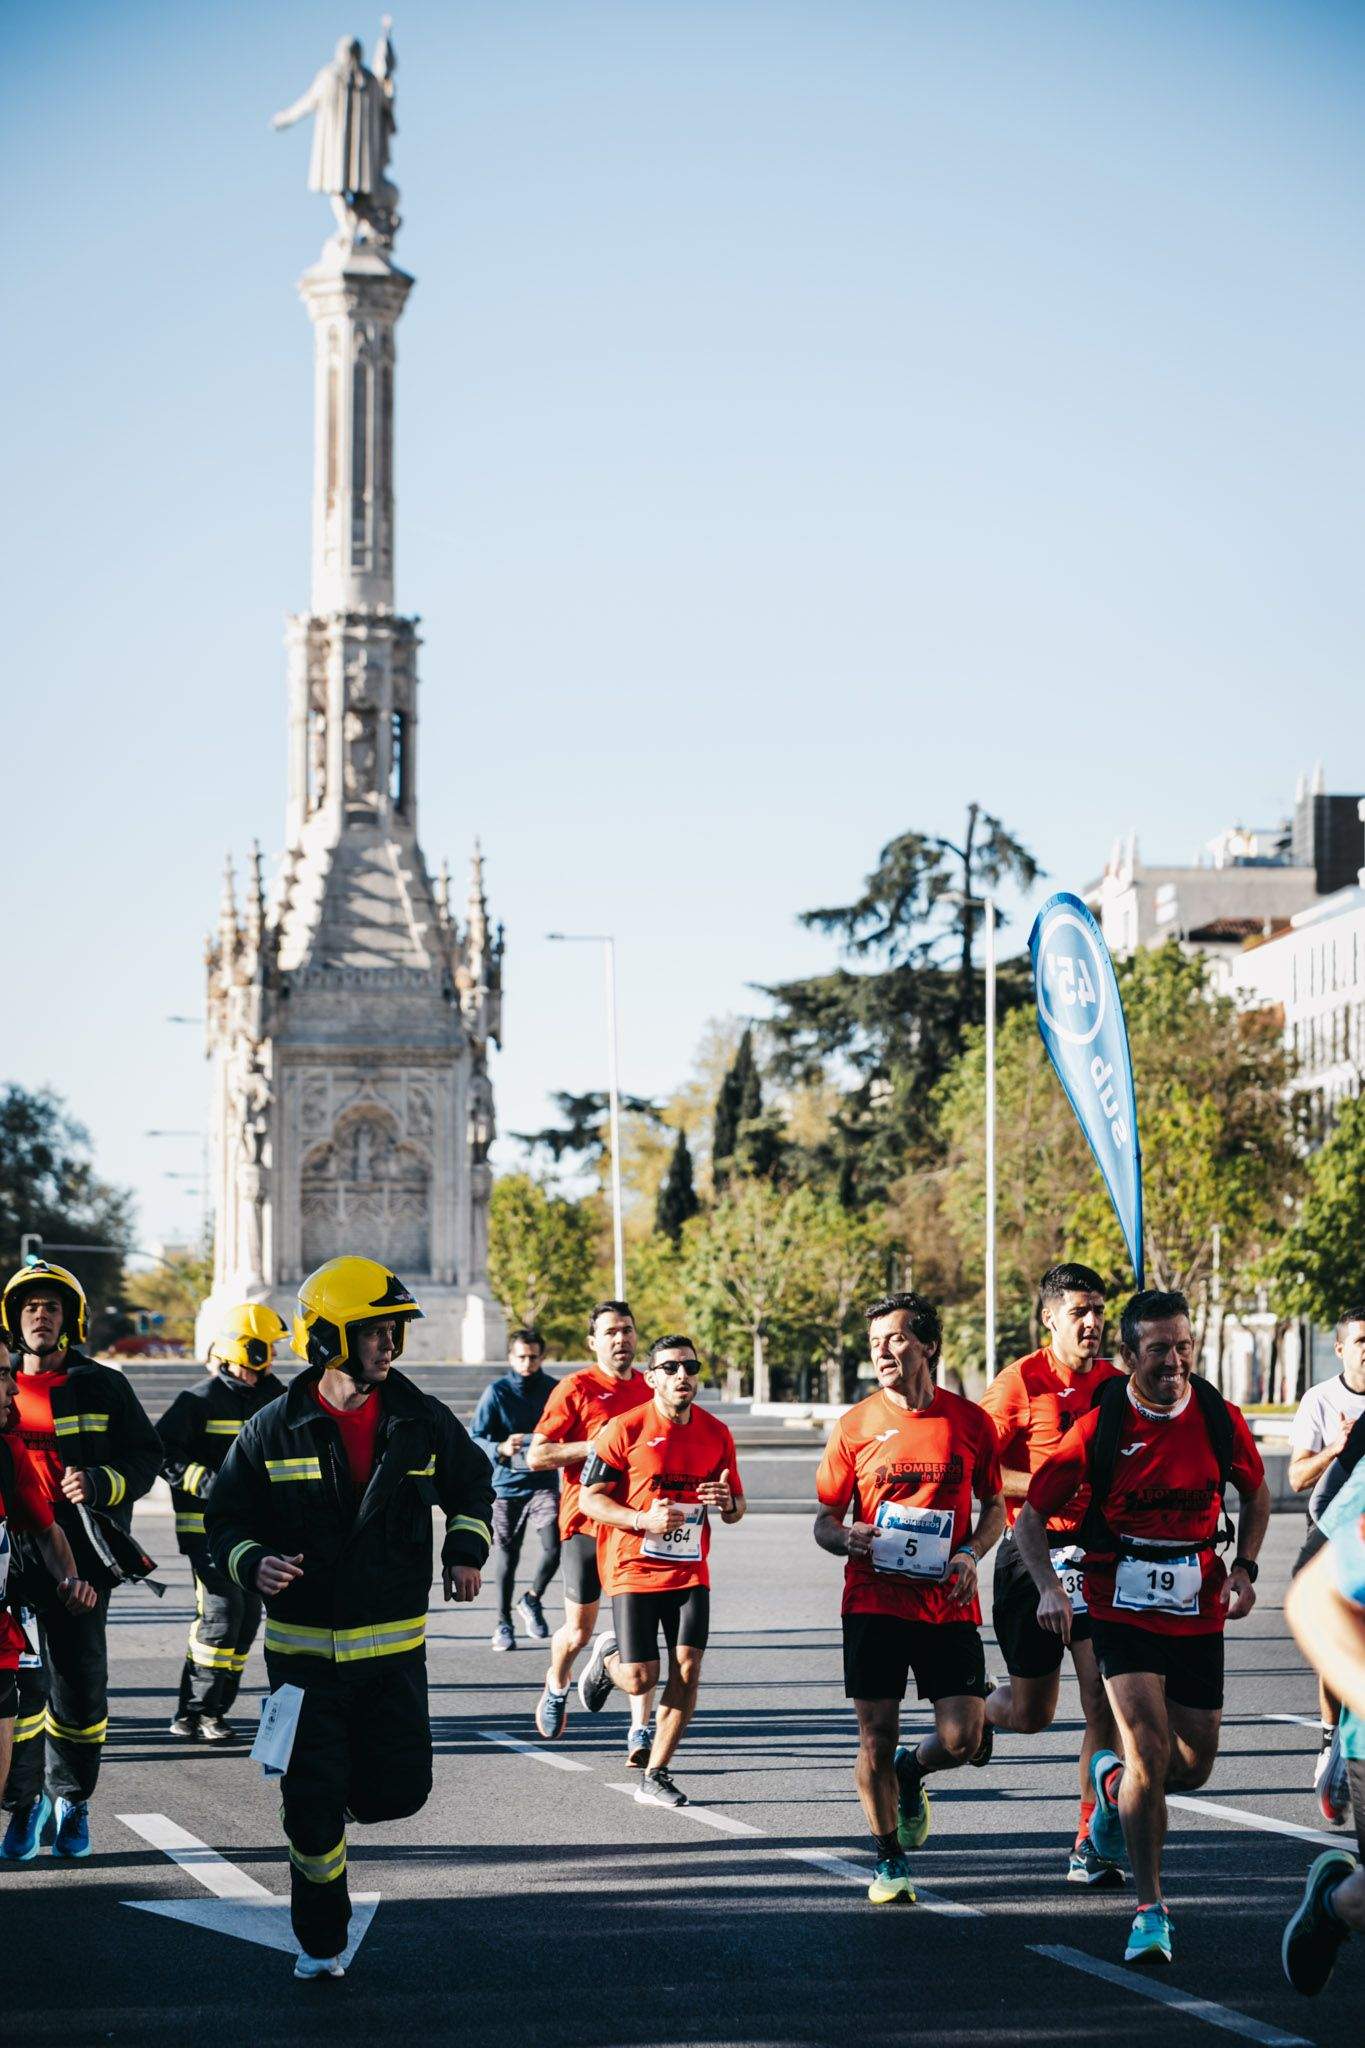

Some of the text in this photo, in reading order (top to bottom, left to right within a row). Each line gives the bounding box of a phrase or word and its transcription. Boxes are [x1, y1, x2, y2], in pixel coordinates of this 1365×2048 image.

[895, 1463, 962, 1474] BOMBEROS
[921, 1472, 931, 1481] de
[904, 1538, 918, 1557] 5
[1146, 1569, 1175, 1590] 19
